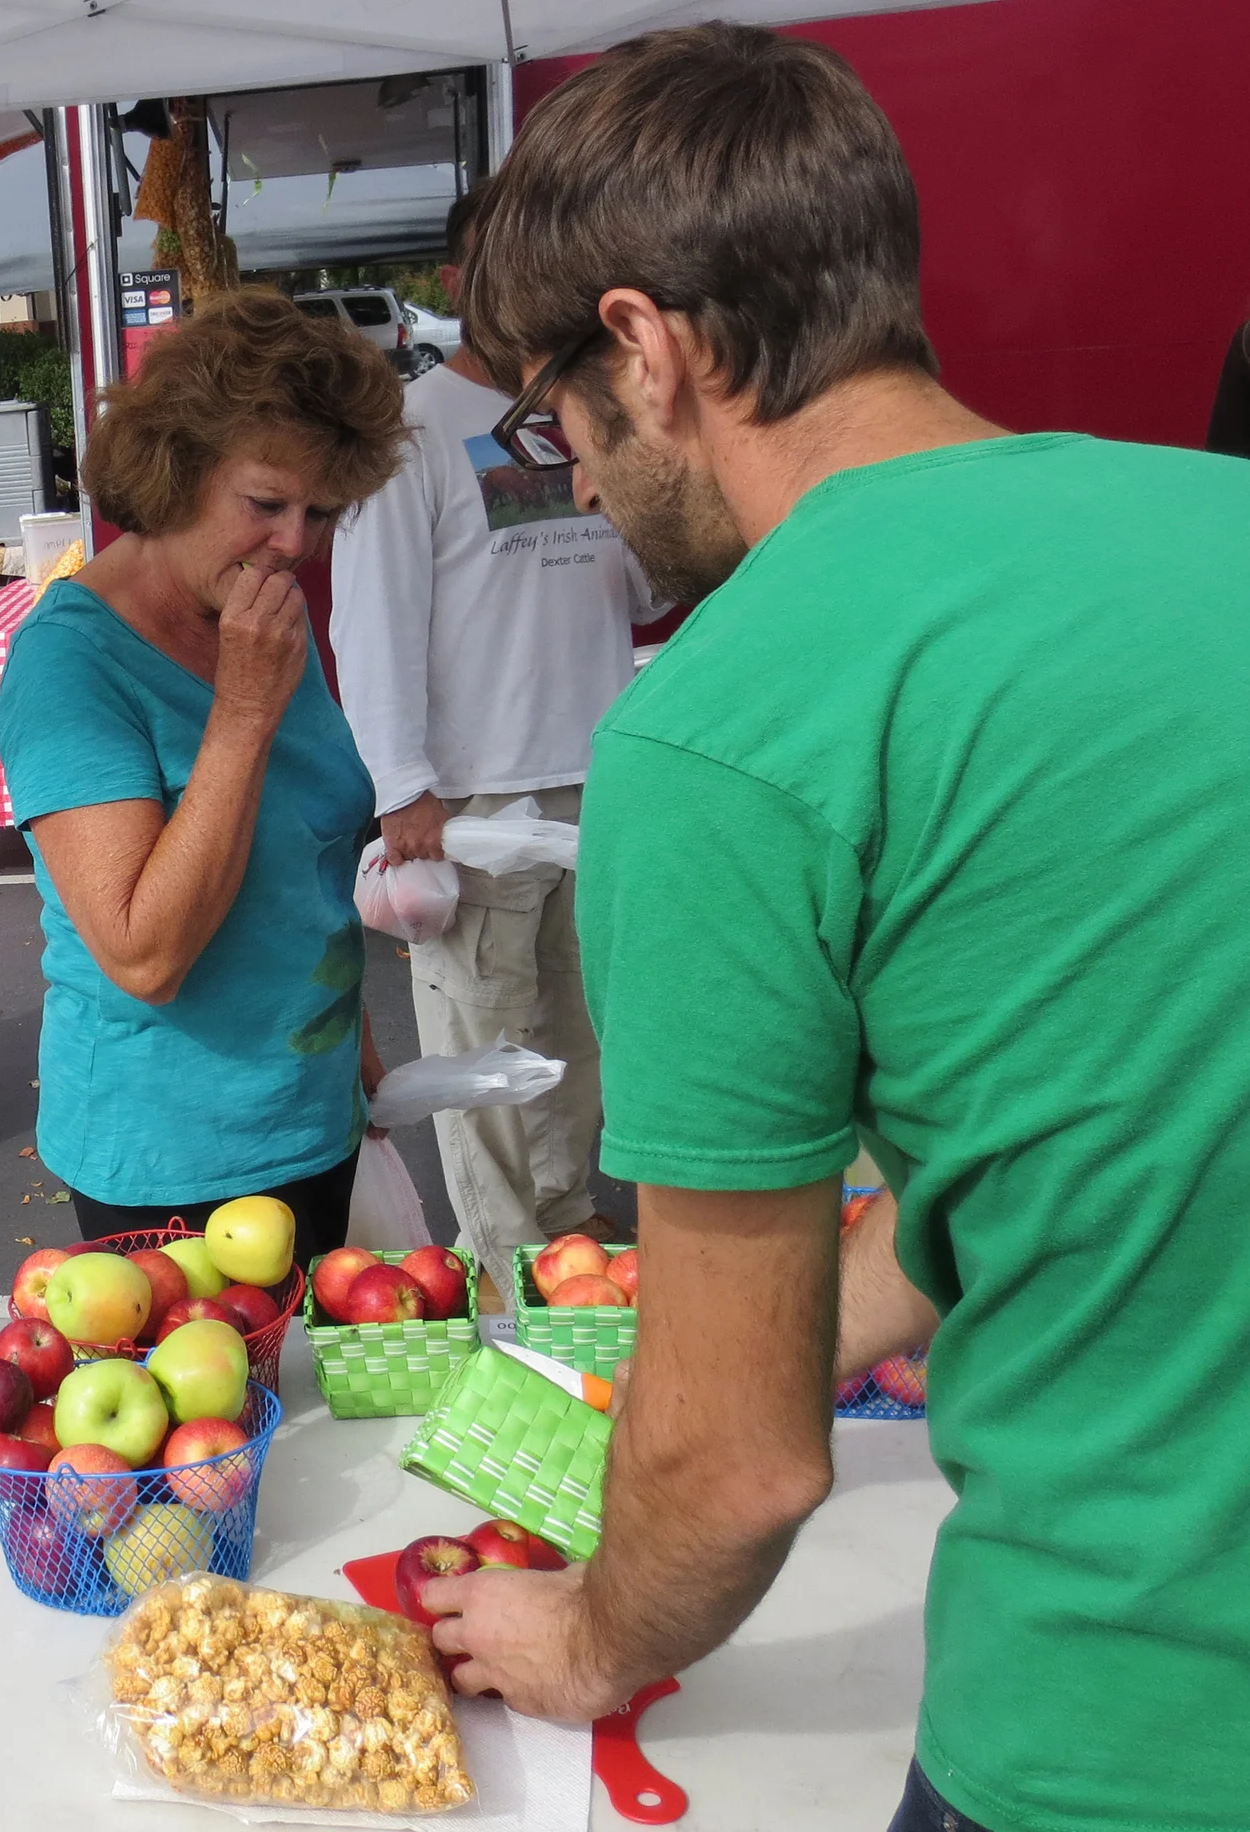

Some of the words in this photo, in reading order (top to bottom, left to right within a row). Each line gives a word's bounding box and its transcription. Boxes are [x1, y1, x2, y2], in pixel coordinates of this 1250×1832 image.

[135, 273, 171, 285] Square
[124, 295, 144, 304] VISA
[491, 531, 549, 556] Laffey's
[553, 527, 577, 545] Irish
[580, 524, 620, 541] Anima
[541, 556, 571, 568] Dexter
[573, 553, 595, 564] Cattle
